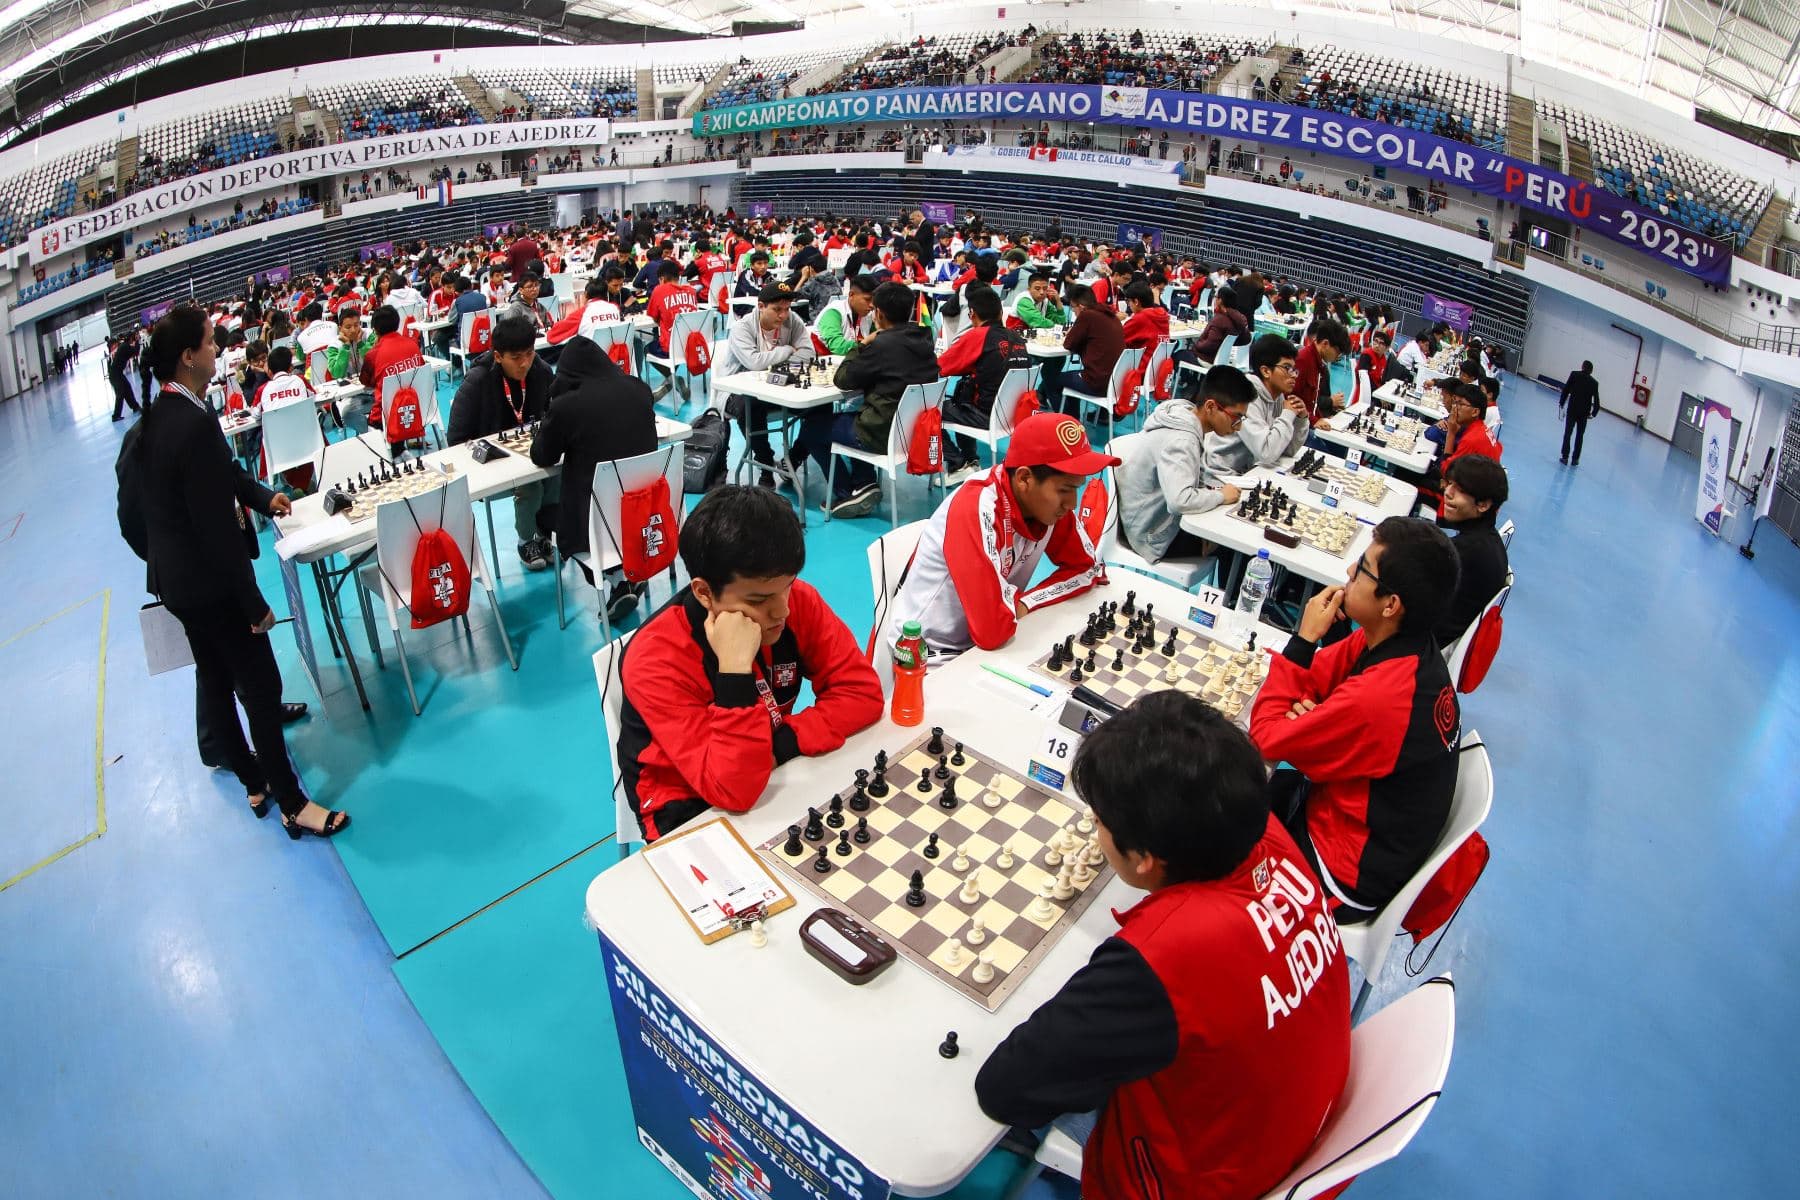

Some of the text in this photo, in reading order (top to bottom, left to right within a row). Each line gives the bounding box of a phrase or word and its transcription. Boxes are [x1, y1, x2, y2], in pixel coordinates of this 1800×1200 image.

[711, 113, 731, 132] XII
[735, 97, 869, 127] CAMPEONATO
[876, 91, 1091, 115] PANAMERICANO
[1145, 97, 1291, 139] AJEDREZ
[1301, 116, 1475, 182] ESCOLAR
[997, 147, 1029, 157] GOBIER
[1080, 153, 1096, 163] DEL
[1097, 155, 1131, 167] CALLAO
[64, 124, 597, 244] FEDERACIÓN DEPORTIVA PERUANA DE AJEDREZ
[591, 312, 619, 323] PERU
[269, 388, 300, 402] PERU
[1330, 485, 1340, 495] 16
[1203, 591, 1219, 605] 17
[1048, 738, 1069, 759] 18
[1246, 856, 1316, 953] PERÚ
[1260, 905, 1340, 1031] AJEDRE
[612, 952, 864, 1186] XII CAMPEONATO
[615, 973, 863, 1200] PANAMERICANO ESCOLAR
[641, 1031, 678, 1073] SUB
[683, 1073, 704, 1097] 17
